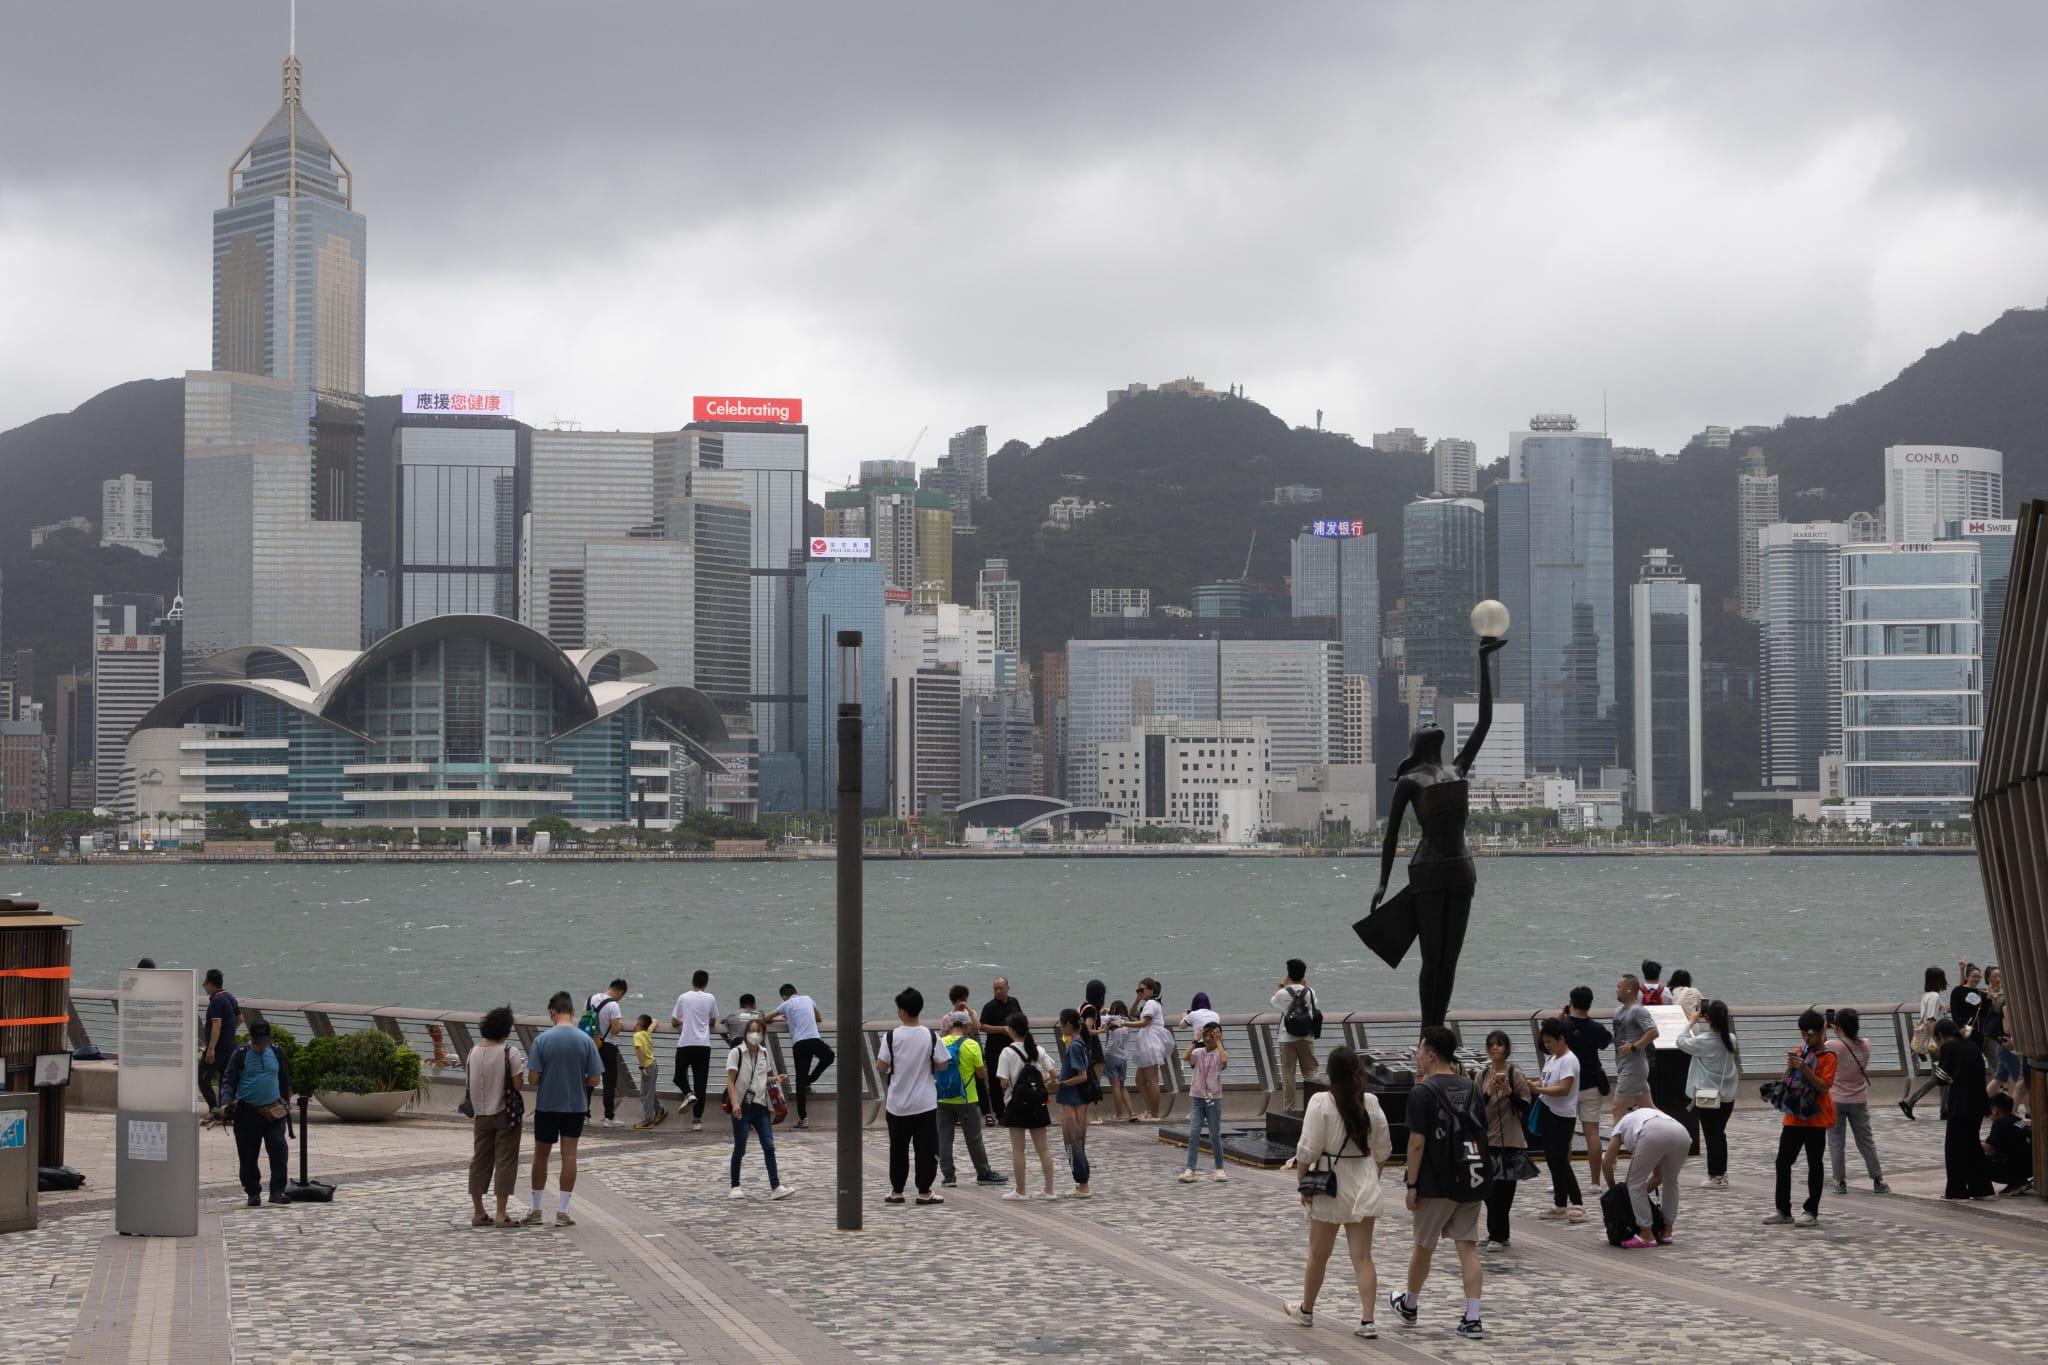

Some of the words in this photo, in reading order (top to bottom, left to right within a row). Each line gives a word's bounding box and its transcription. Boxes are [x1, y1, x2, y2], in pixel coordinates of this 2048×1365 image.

[416, 393, 500, 411] 應援您健康
[706, 401, 790, 420] Celebrating
[1905, 453, 1959, 463] CONRAD
[1313, 520, 1363, 536] 浦发银行
[1986, 523, 2013, 532] SWIRE
[1901, 543, 1932, 552] CITIC
[1463, 1141, 1484, 1188] FILA
